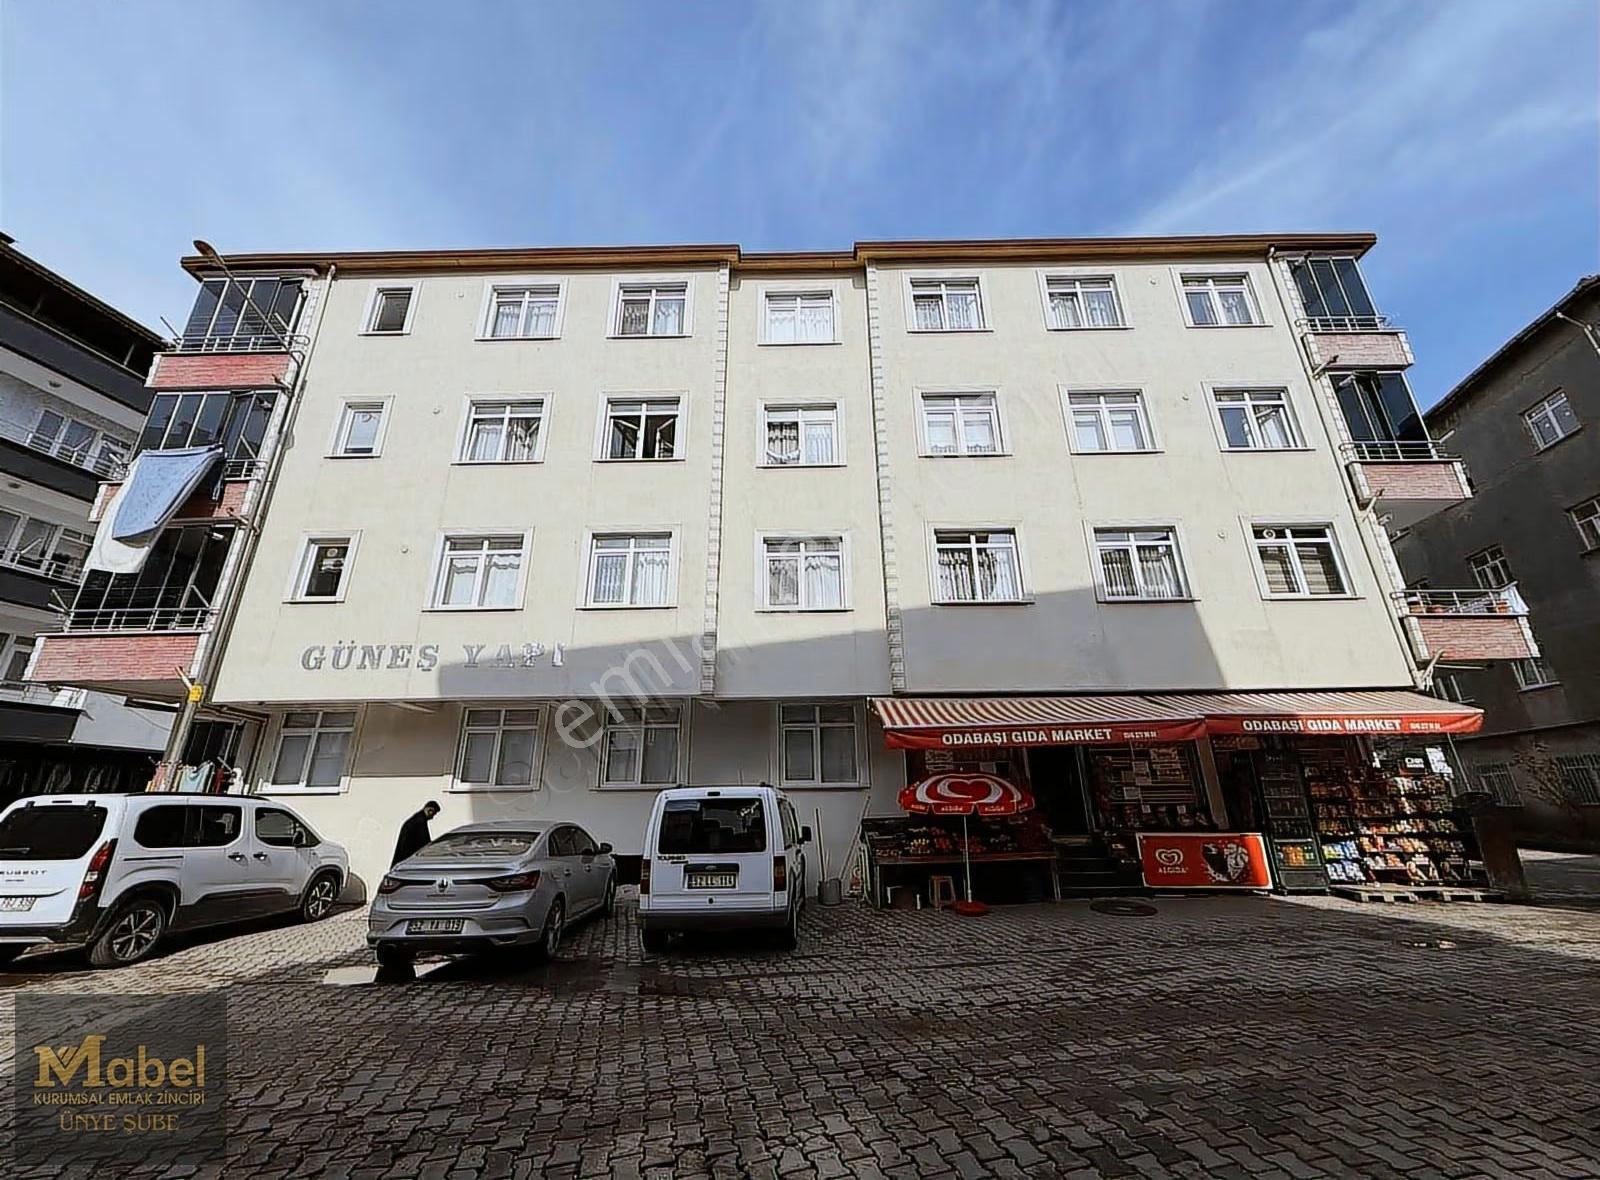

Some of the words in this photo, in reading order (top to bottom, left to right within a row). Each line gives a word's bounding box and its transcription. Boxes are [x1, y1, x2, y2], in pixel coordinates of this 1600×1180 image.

[300, 640, 439, 671] GÜNEŞ
[462, 642, 565, 668] YAPI
[1243, 720, 1304, 734] ODABAŞI
[1307, 719, 1342, 732] GIDA
[1346, 718, 1401, 731] MARKET
[942, 732, 1007, 746] ODABAŞI
[1012, 730, 1048, 743] GIDA
[1051, 729, 1113, 742] MARKET
